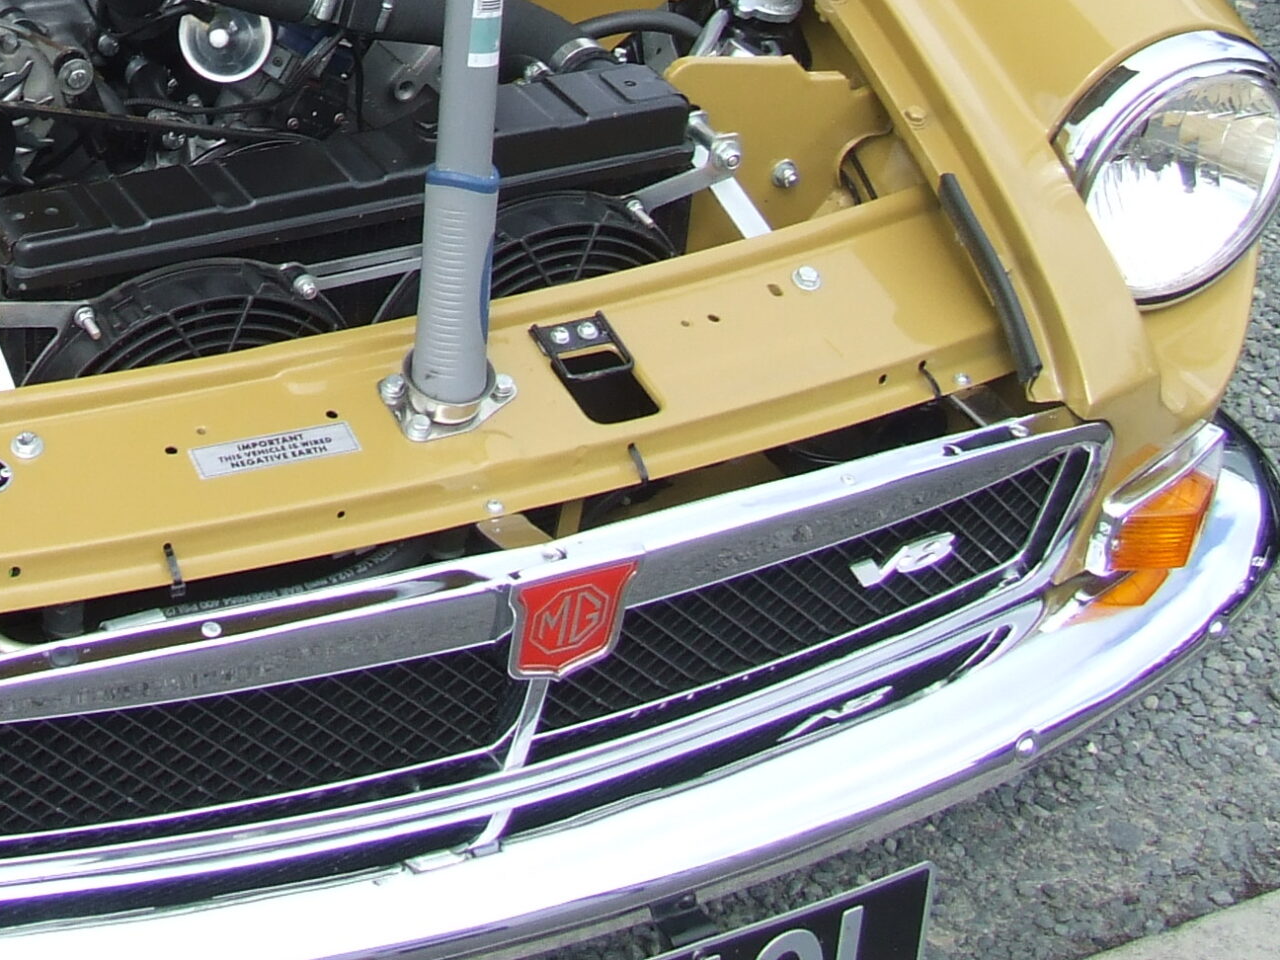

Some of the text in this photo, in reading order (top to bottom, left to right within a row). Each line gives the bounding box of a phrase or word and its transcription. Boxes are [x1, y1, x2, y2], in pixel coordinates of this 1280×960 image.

[218, 436, 333, 464] THIS VEHICLE IS WIRED
[230, 444, 329, 469] NEGATIVE EARTH
[237, 433, 304, 452] IMPORTANT
[849, 531, 956, 588] V8
[538, 591, 603, 647] MG
